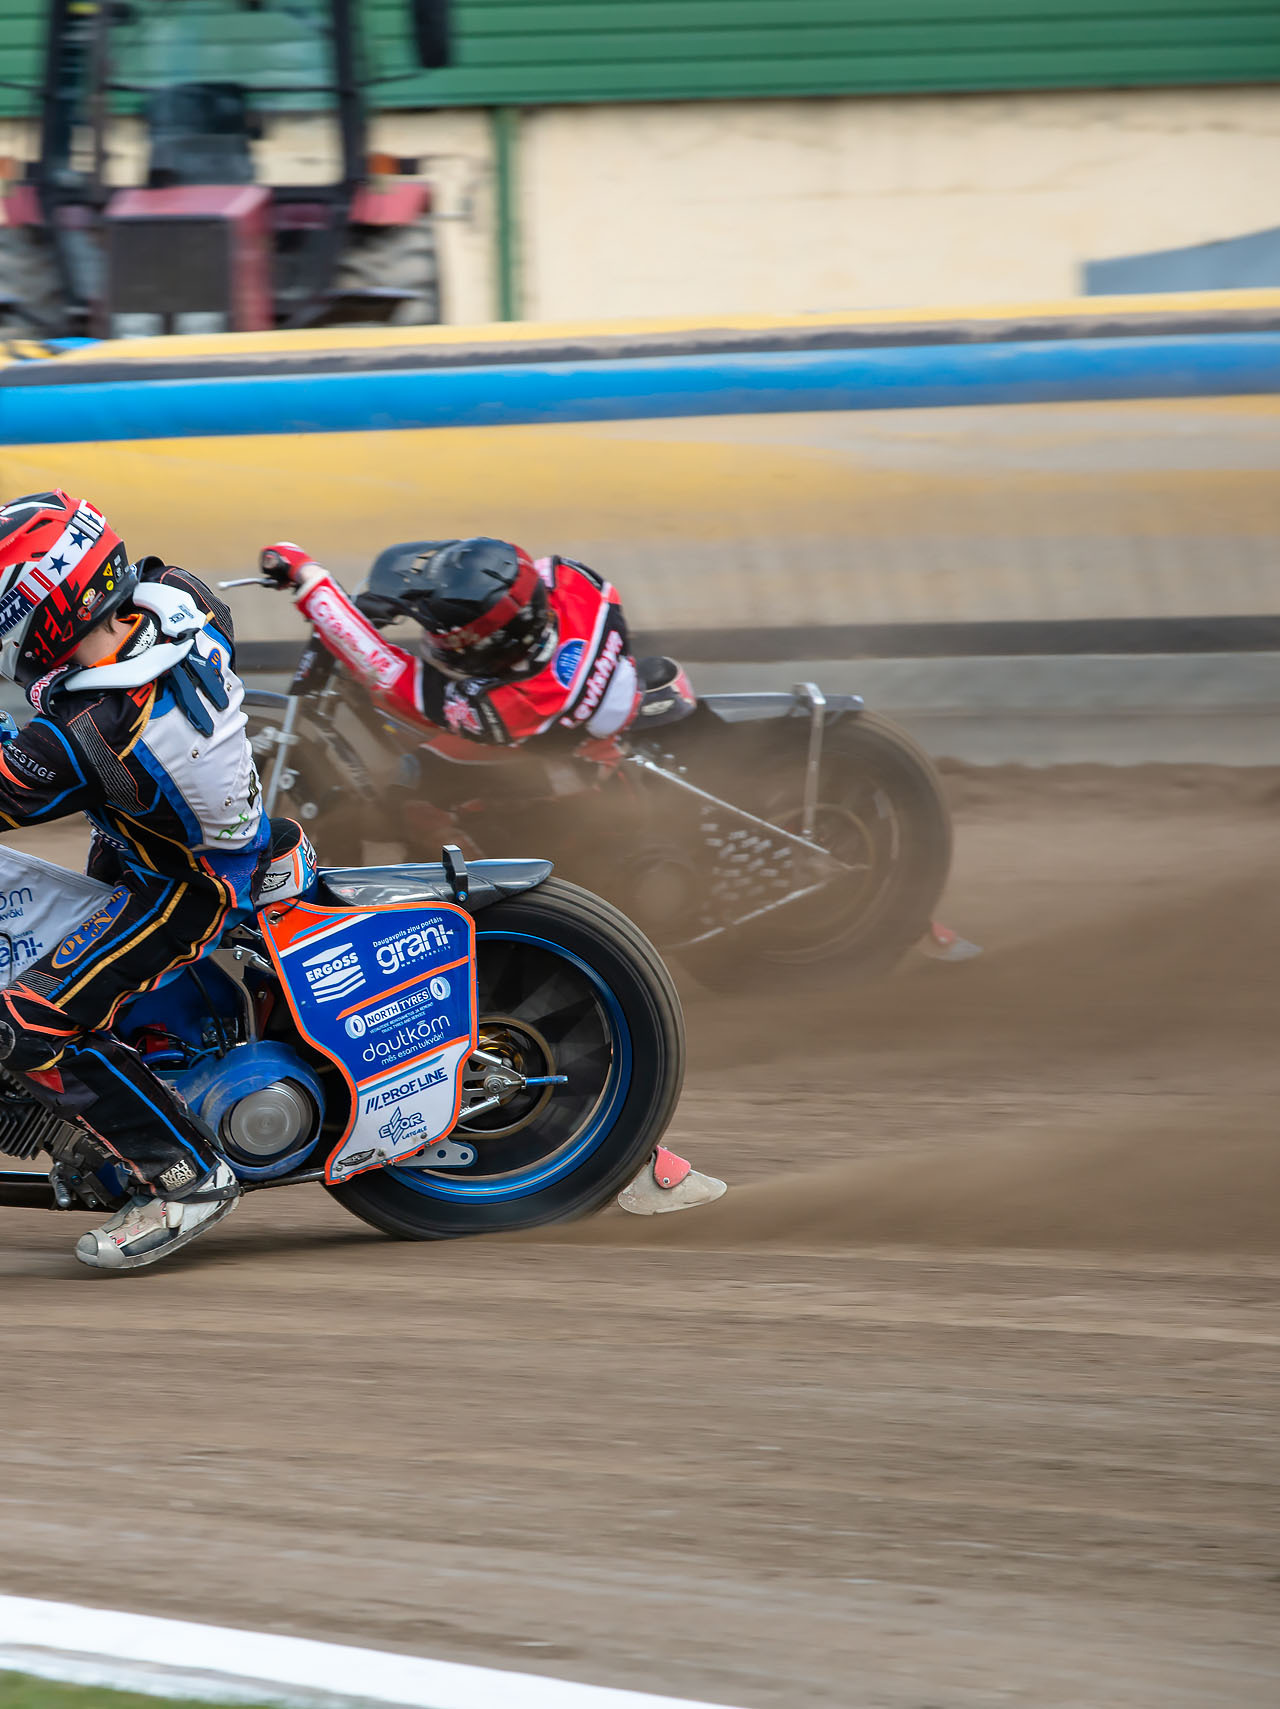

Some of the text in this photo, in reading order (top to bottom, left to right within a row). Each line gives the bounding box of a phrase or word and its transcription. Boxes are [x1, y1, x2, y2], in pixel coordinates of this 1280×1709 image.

[5, 743, 57, 782] RESTIGE
[372, 929, 407, 948] Daugavpils
[305, 952, 359, 983] ERGOSS
[366, 990, 430, 1025] NORTH TYRES
[397, 1044, 419, 1058] esam
[378, 1106, 425, 1146] EVOR
